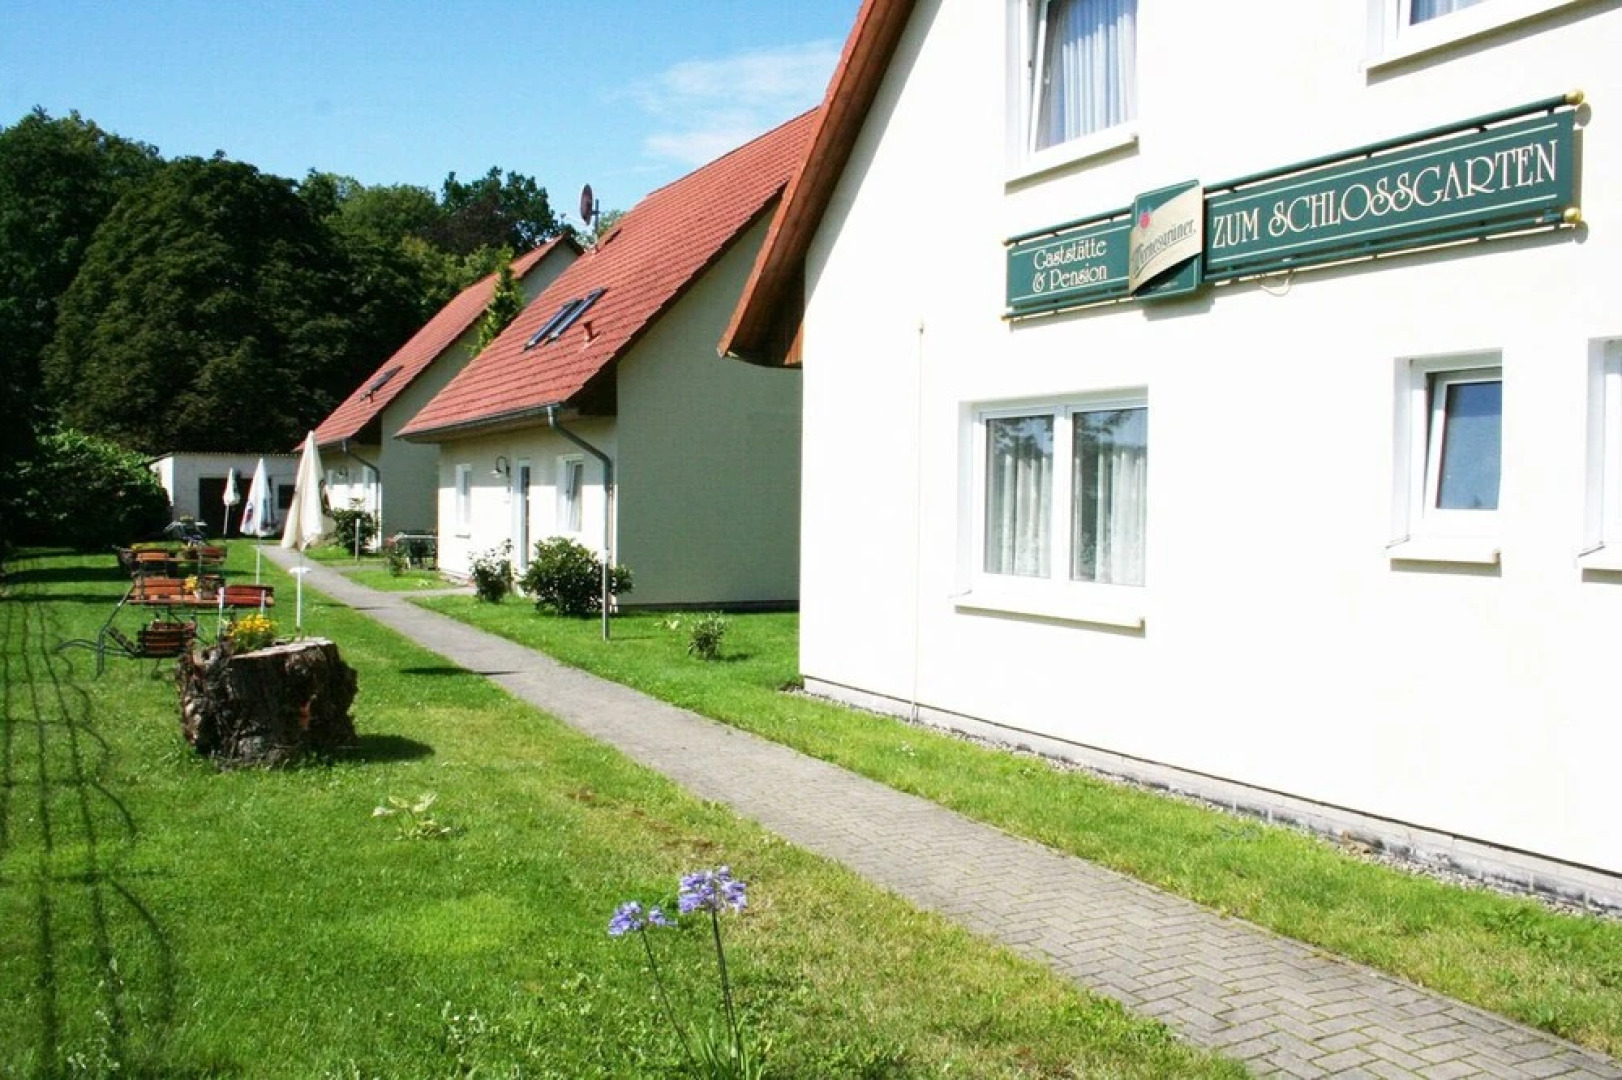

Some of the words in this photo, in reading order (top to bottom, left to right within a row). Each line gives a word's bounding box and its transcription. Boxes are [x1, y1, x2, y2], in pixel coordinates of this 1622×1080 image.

[1212, 206, 1260, 249] ZUM
[1268, 139, 1558, 238] SCHLOSSGARTEN
[1034, 238, 1107, 270] Gaststätte
[1032, 271, 1046, 293] &
[1050, 263, 1107, 290] Pension
